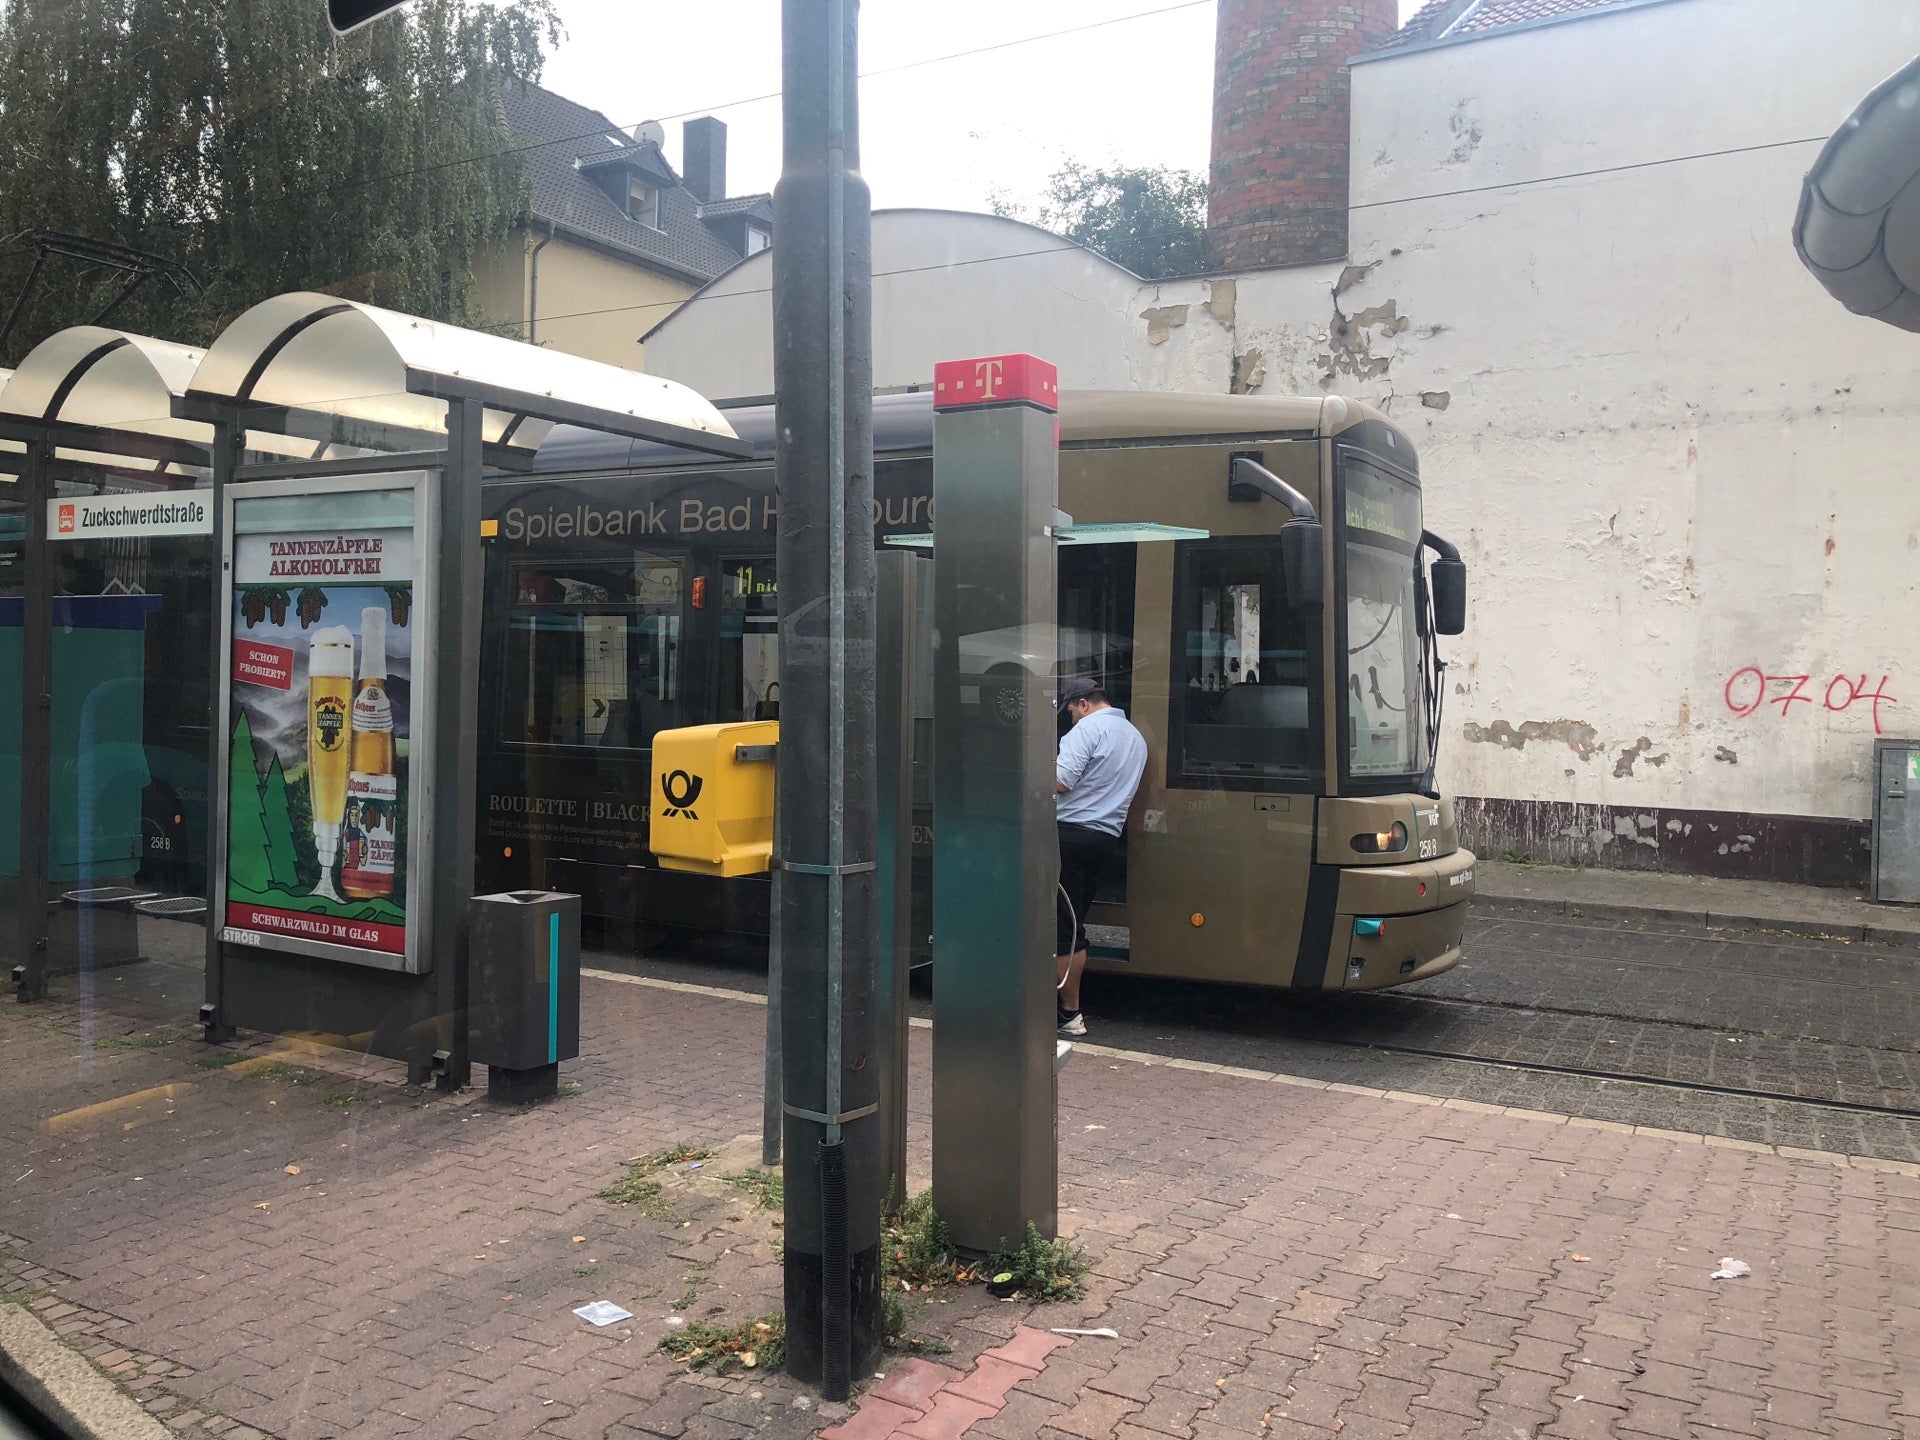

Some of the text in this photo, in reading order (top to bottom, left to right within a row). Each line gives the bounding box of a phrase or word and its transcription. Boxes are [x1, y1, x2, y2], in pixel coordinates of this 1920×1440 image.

[81, 501, 204, 528] Zuckschwerdtstraße
[504, 501, 667, 546] Spielbank
[679, 496, 752, 533] Bad
[269, 536, 382, 556] TANNENZÄPFLE
[269, 557, 382, 576] ALKOHOLFREI
[736, 566, 778, 594] 11 nic
[249, 650, 279, 664] SCHON
[239, 662, 287, 680] PROBIERT?
[488, 794, 577, 817] ROULETTE
[150, 836, 164, 849] 258
[1419, 840, 1432, 858] 258
[251, 912, 379, 943] SCHWARZWALD IM GLAS
[223, 929, 261, 946] STRÖER
